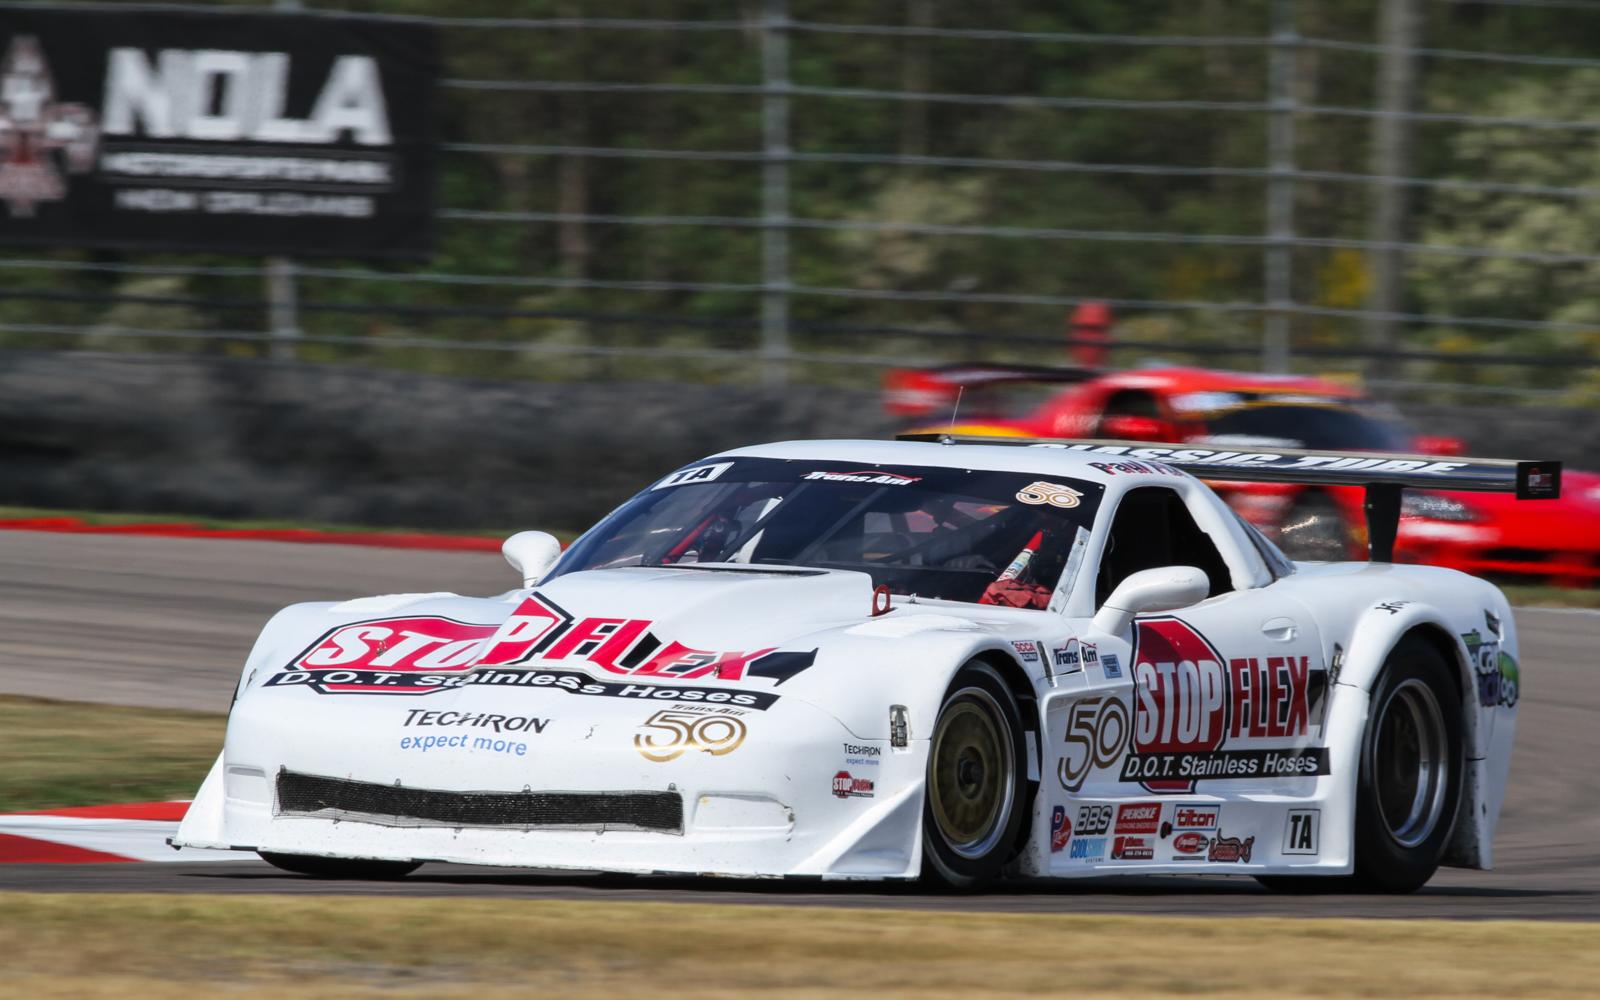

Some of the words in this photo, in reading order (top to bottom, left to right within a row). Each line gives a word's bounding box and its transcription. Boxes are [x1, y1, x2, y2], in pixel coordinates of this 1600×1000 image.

[102, 47, 393, 145] NOLA
[671, 466, 718, 484] TA
[1297, 455, 1469, 476] TUBE
[804, 471, 871, 483] Trans
[866, 475, 913, 486] Am
[306, 614, 555, 669] STOP
[542, 617, 779, 681] FLEX
[1014, 642, 1036, 653] SCCA
[1052, 647, 1079, 665] Trans
[1080, 646, 1098, 663] Am
[275, 671, 399, 686] D.O.T.
[414, 672, 605, 695] Stainless
[620, 685, 758, 706] Hoses
[1135, 660, 1222, 745] STOP
[1229, 656, 1309, 738] FLEX
[400, 734, 469, 752] expect
[473, 737, 527, 756] more
[634, 709, 748, 762] 50
[1058, 697, 1130, 792] 50
[1125, 755, 1173, 778] D.O.T.
[1179, 754, 1258, 777] Stainless
[1263, 753, 1319, 774] Hoses
[832, 778, 853, 791] STOP
[1074, 804, 1113, 836] BBS
[1120, 807, 1158, 820] PENSKE
[1290, 814, 1312, 849] TA
